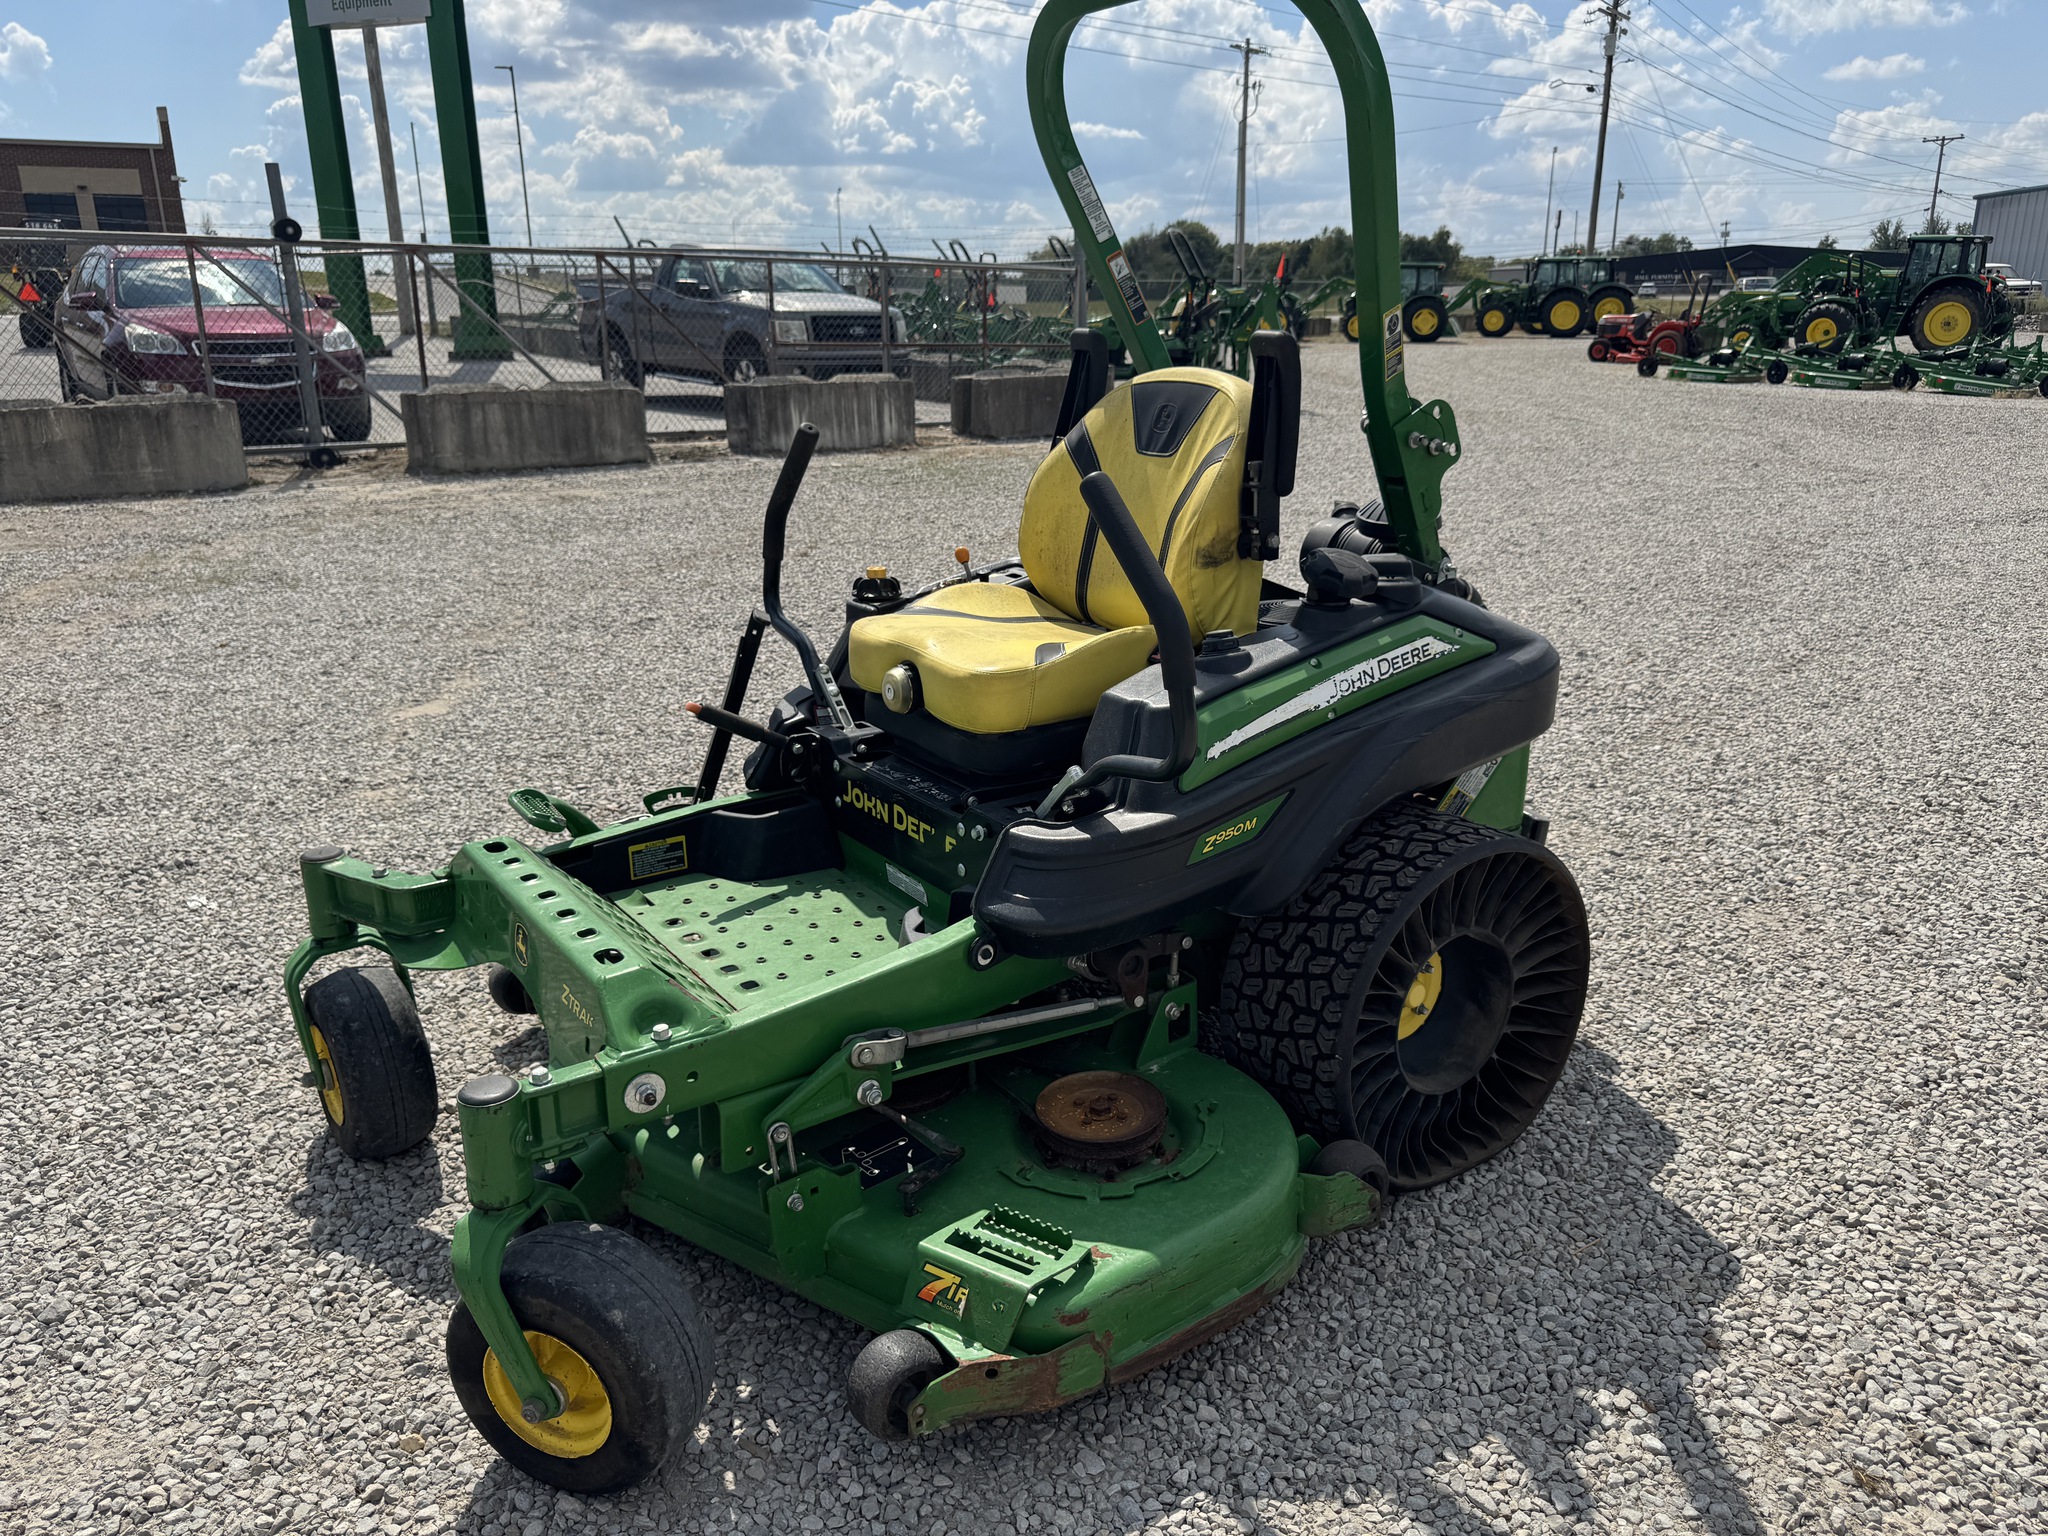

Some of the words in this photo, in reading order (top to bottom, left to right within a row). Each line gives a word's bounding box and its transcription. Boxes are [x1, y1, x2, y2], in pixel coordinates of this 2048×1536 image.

[332, 0, 392, 13] Equipment
[1329, 665, 1376, 700] JOHN
[1377, 642, 1432, 680] DEERE
[842, 780, 890, 824] JOHN
[1202, 817, 1258, 853] Z950M
